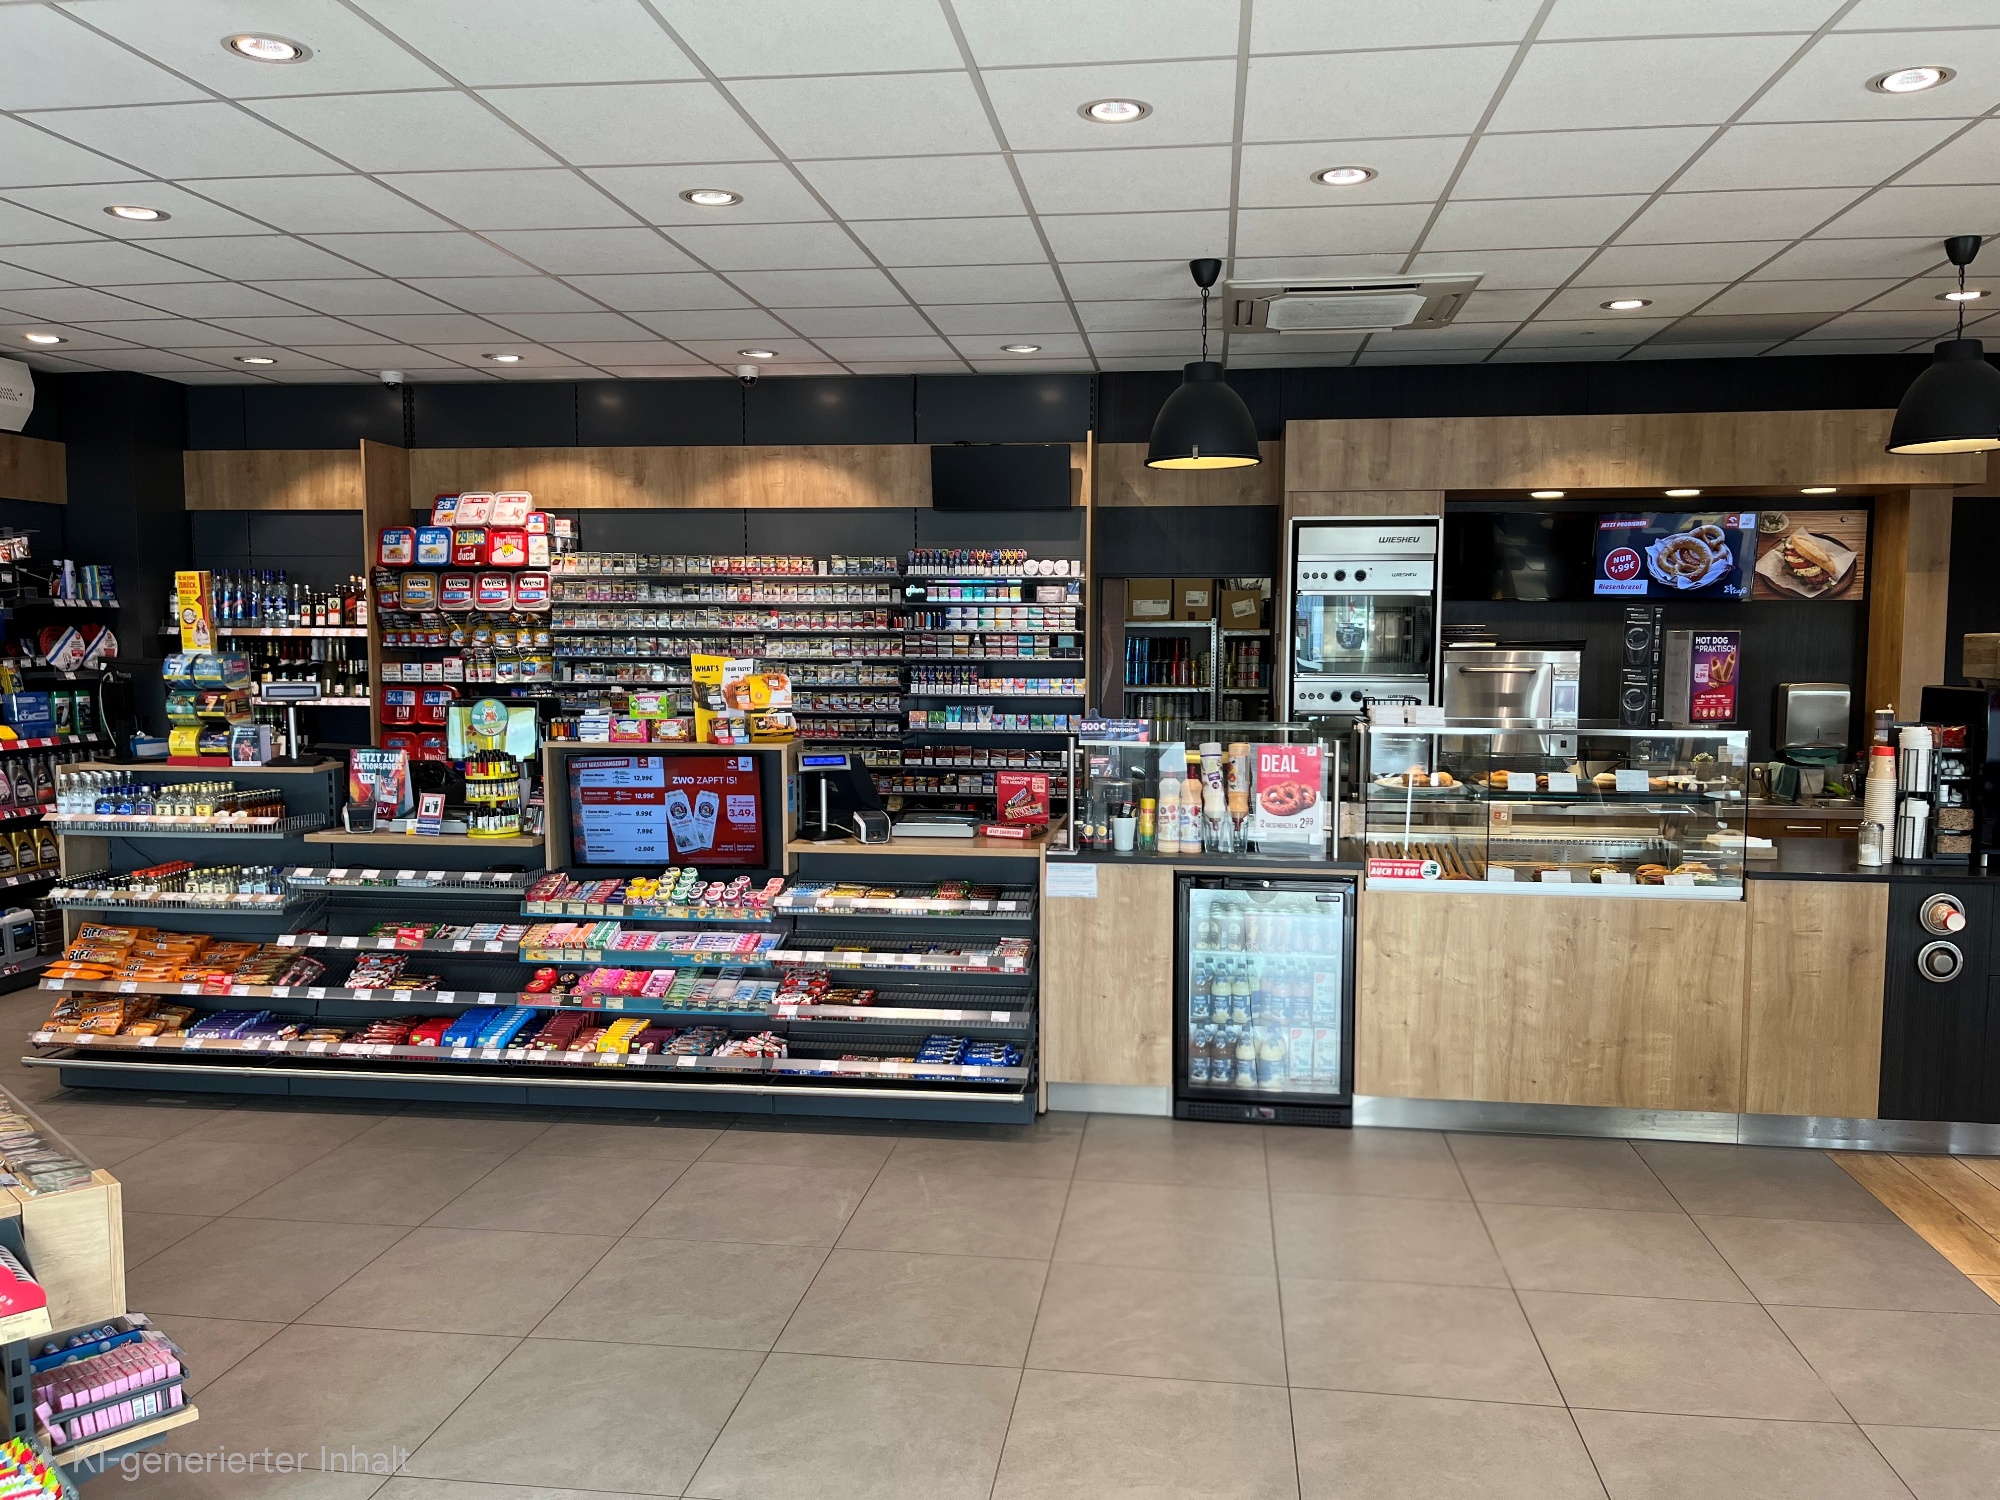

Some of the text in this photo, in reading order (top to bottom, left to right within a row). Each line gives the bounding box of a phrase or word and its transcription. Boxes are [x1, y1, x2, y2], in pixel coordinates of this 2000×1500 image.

[458, 548, 476, 560] ducal
[1613, 554, 1632, 564] NUR
[1610, 560, 1635, 574] 1,99€
[1696, 636, 1728, 644] HOT DOG
[1082, 722, 1106, 730] 500€
[354, 753, 402, 762] JETZT ZUM
[1262, 754, 1299, 772] DEAL
[672, 776, 738, 784] ZWO ZAPFT IS!
[1260, 820, 1264, 828] 2
[1370, 867, 1419, 876] AUCH TO GO!
